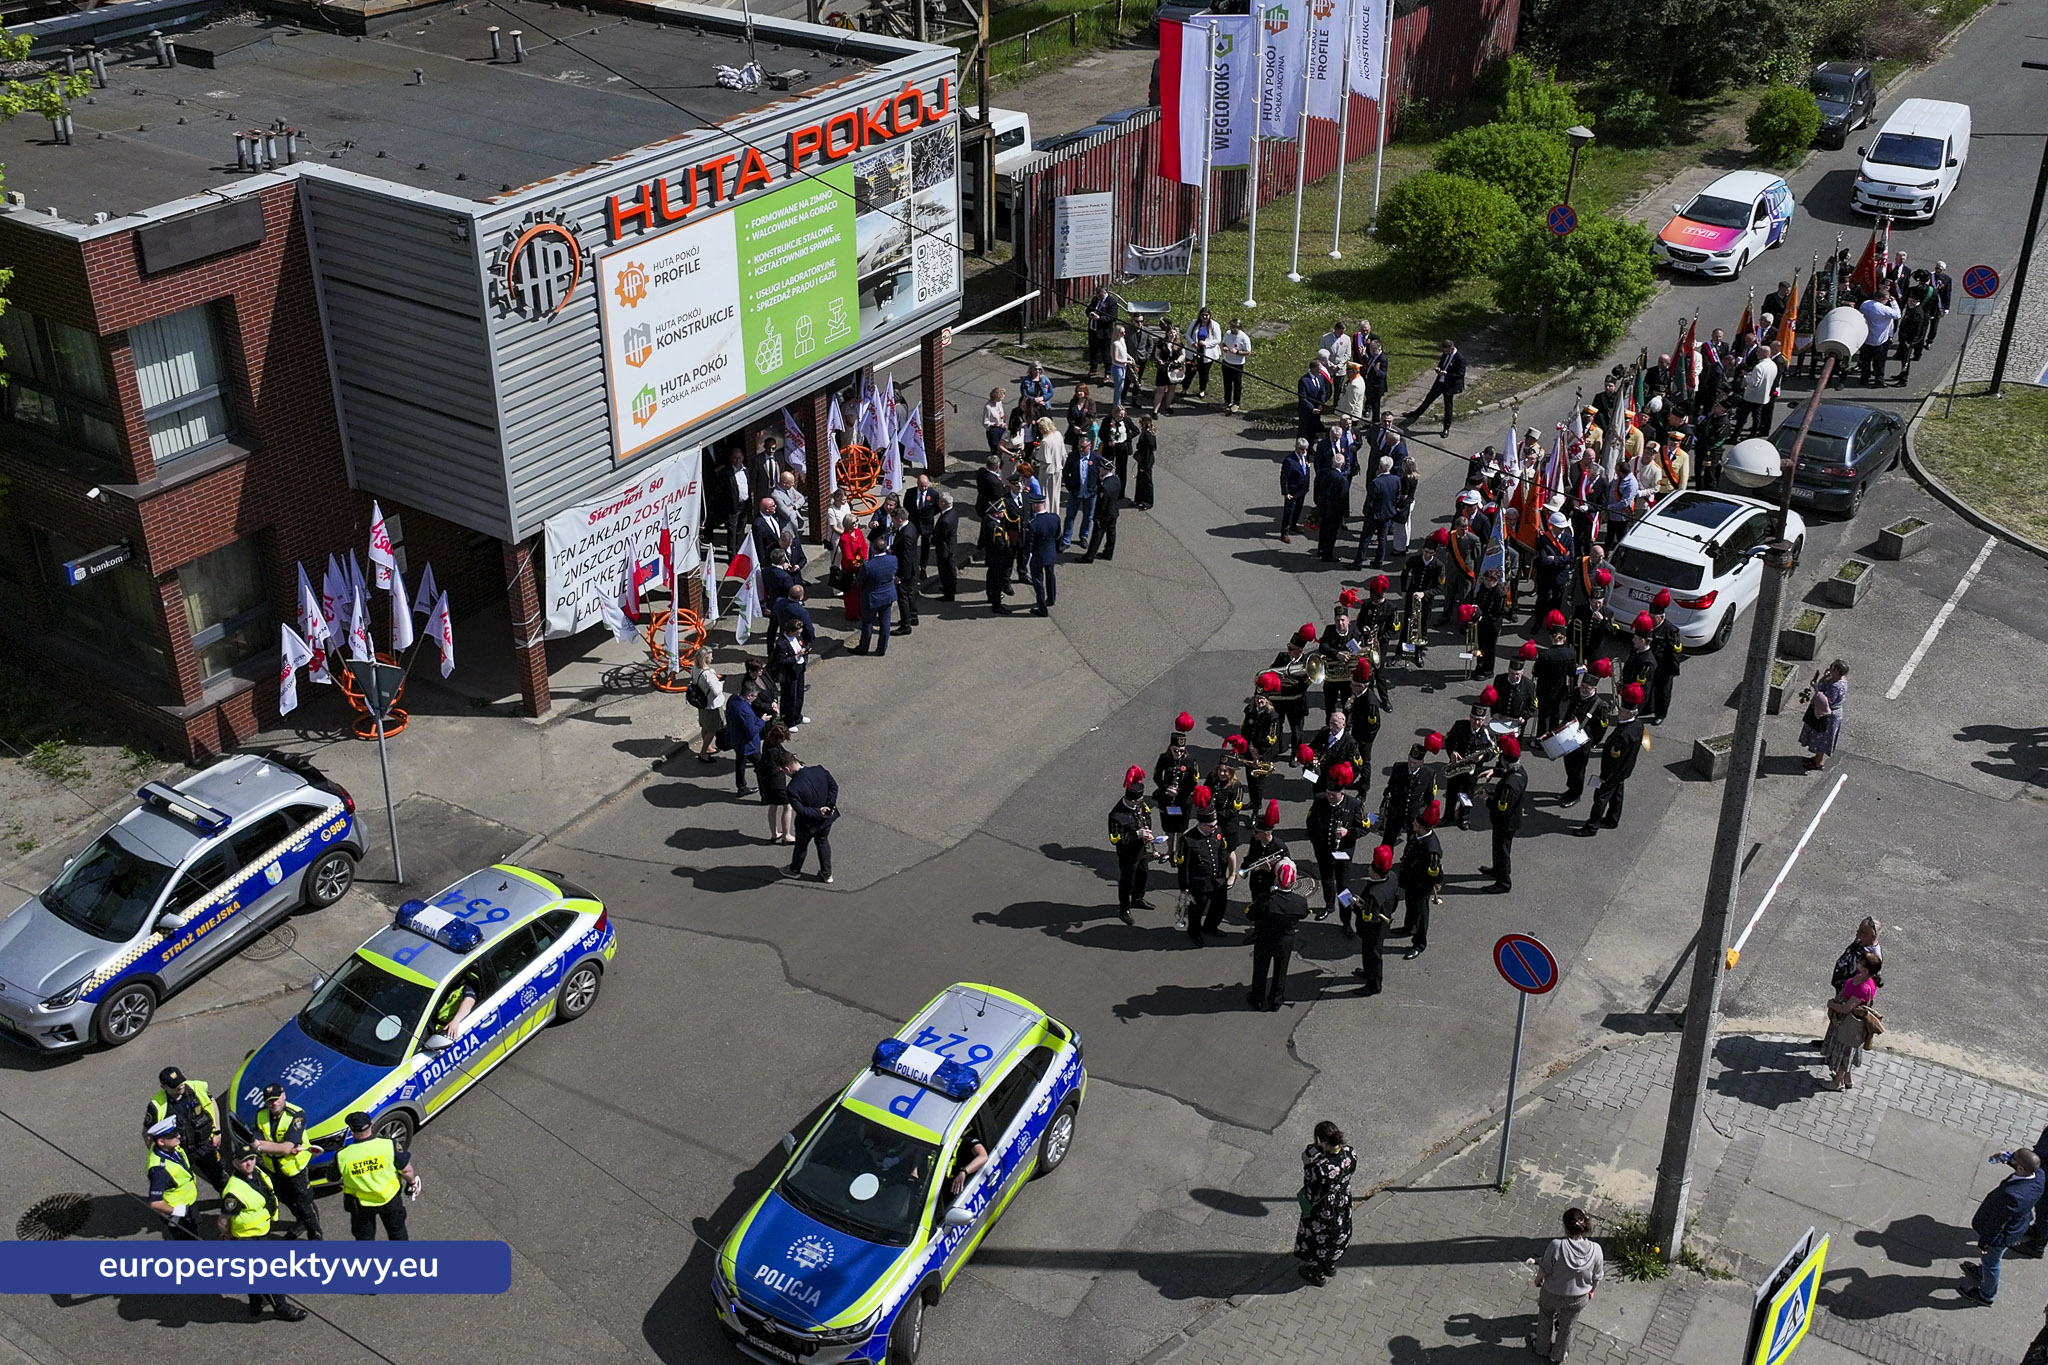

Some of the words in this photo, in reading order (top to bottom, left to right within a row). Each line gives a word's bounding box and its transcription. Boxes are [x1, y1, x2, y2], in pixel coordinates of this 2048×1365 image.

[1316, 29, 1329, 80] PROFILE
[1362, 5, 1370, 80] KONSTRUKCJE
[1264, 45, 1276, 86] POKÓJ
[1276, 55, 1285, 91] AKCYJNA
[1213, 63, 1233, 150] WĘGLOKOKS
[1262, 88, 1273, 121] HUTA
[1274, 91, 1282, 122] SPÓŁKA
[609, 147, 773, 240] HUTA
[791, 77, 949, 173] POKÓJ
[751, 202, 798, 229] FORMOWANE
[798, 199, 810, 209] NA
[809, 190, 833, 206] ZIMNO
[751, 215, 798, 241] WALCOWANE
[798, 211, 810, 222] NA
[809, 200, 838, 218] GORĄCO
[753, 238, 802, 265] KONSTRUKCJE
[802, 224, 834, 244] STALOWE
[1685, 226, 1718, 240] TVP
[653, 257, 674, 272] HUTA
[675, 246, 700, 263] POKÓJ
[654, 258, 701, 288] PROFILE
[754, 246, 809, 277] KSZTAŁTOWNIKI
[809, 232, 841, 254] SPAWANE
[1137, 255, 1187, 273] WON!!
[755, 283, 781, 300] USŁUGI
[781, 258, 836, 288] LABORATORYJNE
[756, 288, 791, 312] SPRZEDAŻ
[791, 280, 815, 297] PRĄDU
[819, 269, 837, 284] GAZU
[655, 319, 677, 334] HUTA
[677, 307, 702, 323] POKÓJ
[656, 305, 735, 350] KONSTRUKCJE
[660, 372, 691, 396] HUTA
[692, 353, 728, 381] POKÓJ
[661, 389, 690, 408] SPÓŁKA
[690, 374, 722, 395] AKCYJNA
[587, 485, 644, 526] Sierpień
[648, 477, 664, 494] 80
[552, 547, 576, 570] TEN
[578, 515, 631, 555] ZAKŁAD
[632, 481, 698, 525] ZOSTANIE
[90, 551, 130, 575] bankomat
[556, 563, 616, 612] POLITYKĘ
[617, 525, 690, 575] ZILONGO
[562, 529, 642, 589] ZNISZCZONY
[644, 507, 683, 538] PREZ
[330, 818, 347, 836] 986
[161, 932, 195, 962] STRAŻ
[195, 901, 241, 938] MIEJSKA
[411, 919, 437, 939] POLICJA
[582, 931, 600, 951] P654
[392, 942, 431, 966] P
[422, 1033, 480, 1087] POLICJA
[895, 1063, 929, 1085] POLICJA
[351, 1163, 384, 1176] MIEJSKA
[352, 1158, 378, 1170] STRAŻ
[944, 1193, 986, 1253] POLJA
[753, 1264, 822, 1308] POLICJA
